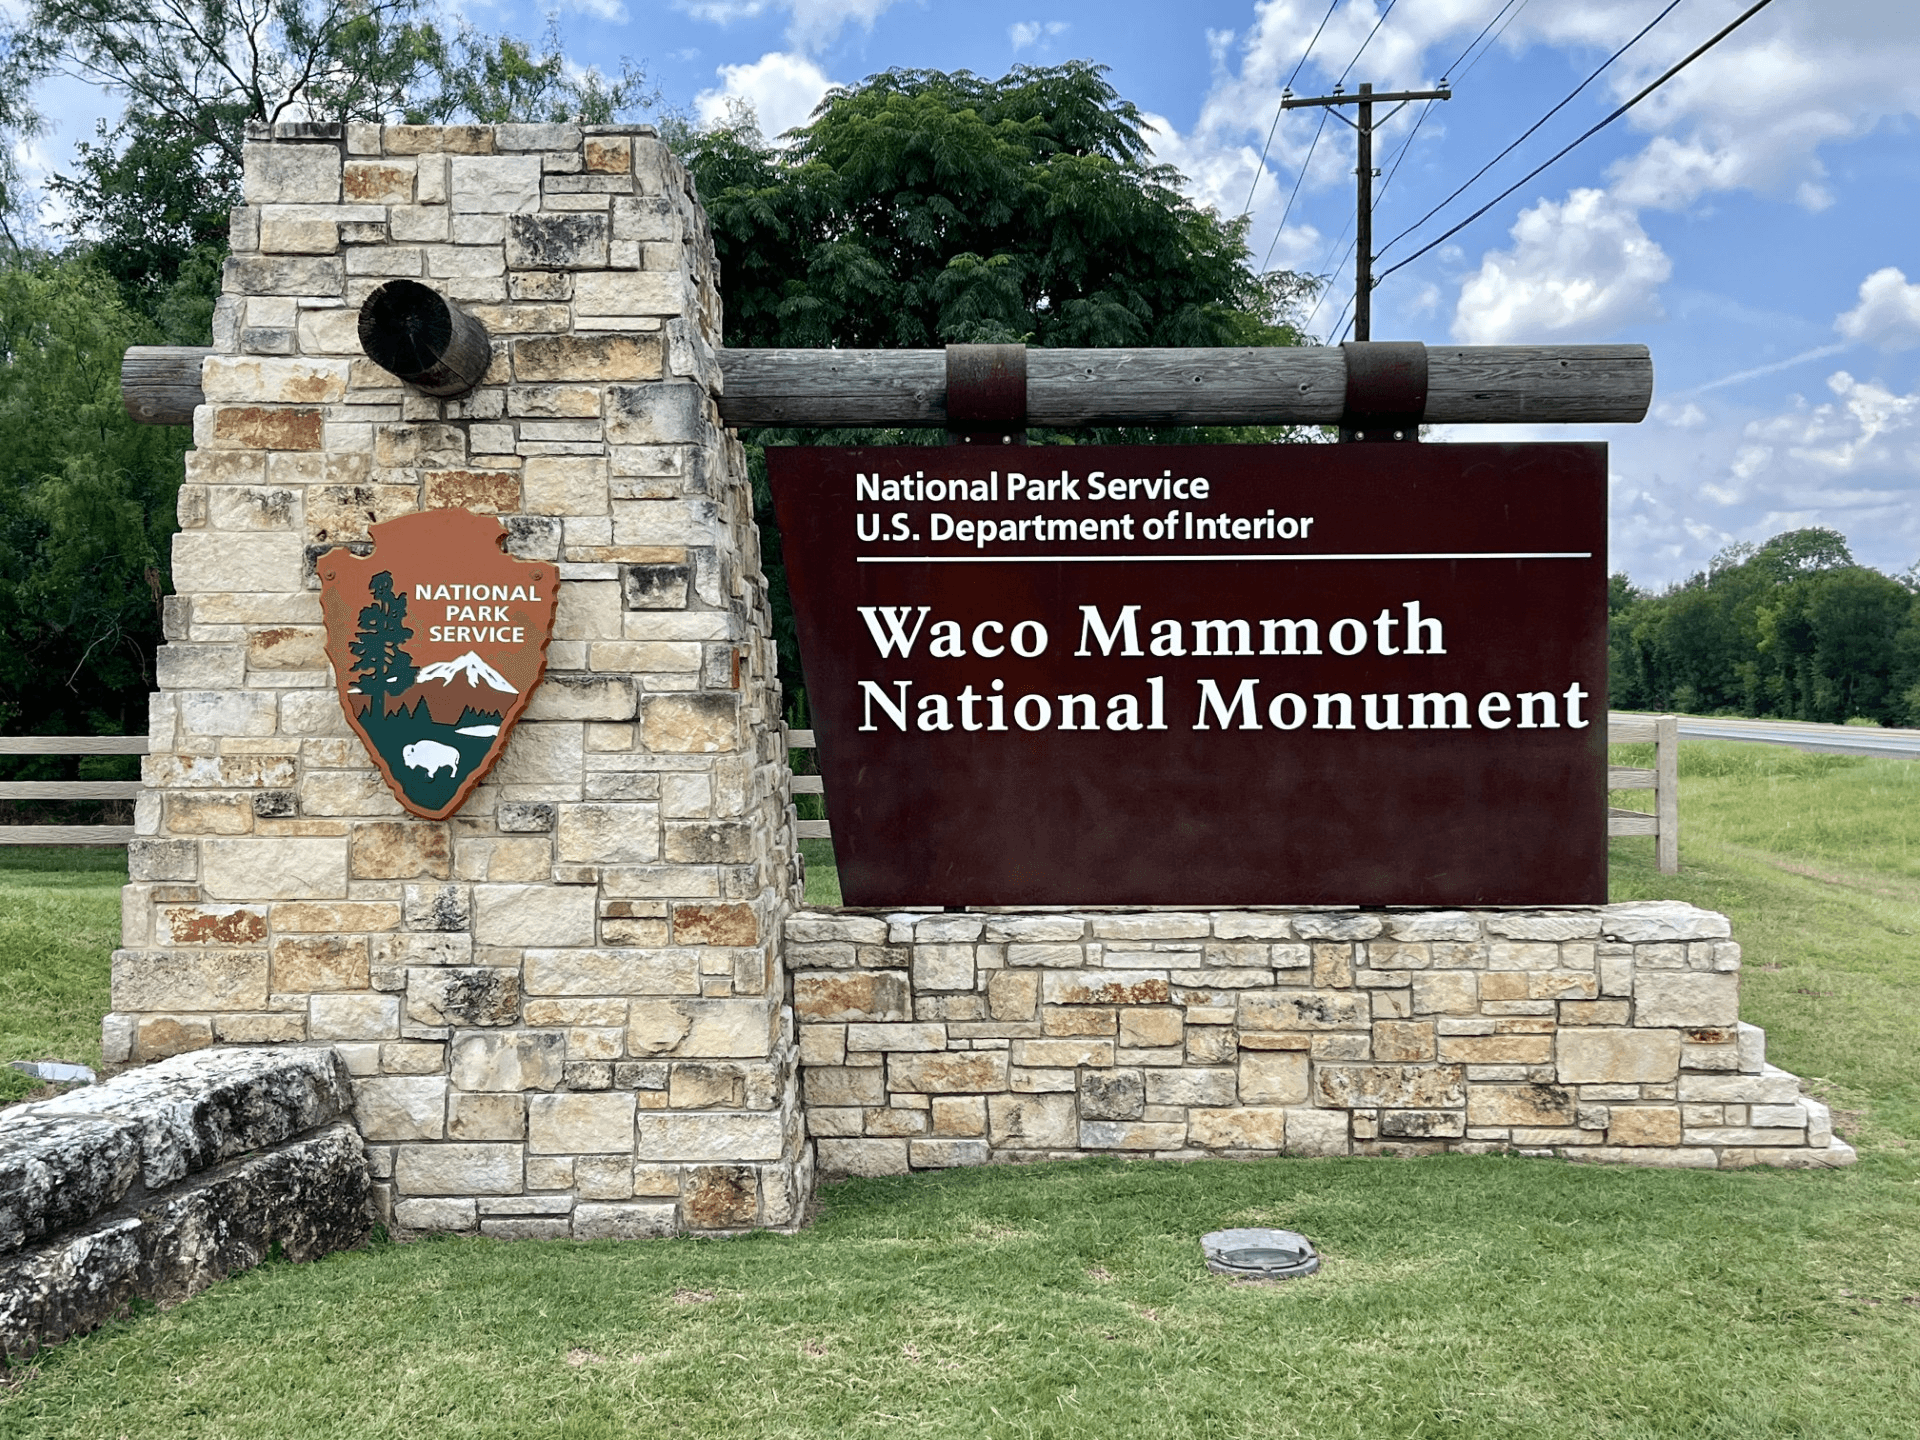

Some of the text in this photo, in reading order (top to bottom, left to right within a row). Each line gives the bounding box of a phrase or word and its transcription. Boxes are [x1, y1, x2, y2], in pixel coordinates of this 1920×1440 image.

[856, 469, 1210, 502] National Park Service
[856, 509, 1314, 549] U.S. Department of Interior
[414, 583, 542, 602] NATIONAL
[446, 605, 510, 622] PARK
[857, 600, 1447, 659] Waco Mammoth
[429, 625, 525, 643] SERVICE
[857, 675, 1590, 732] National Monument
